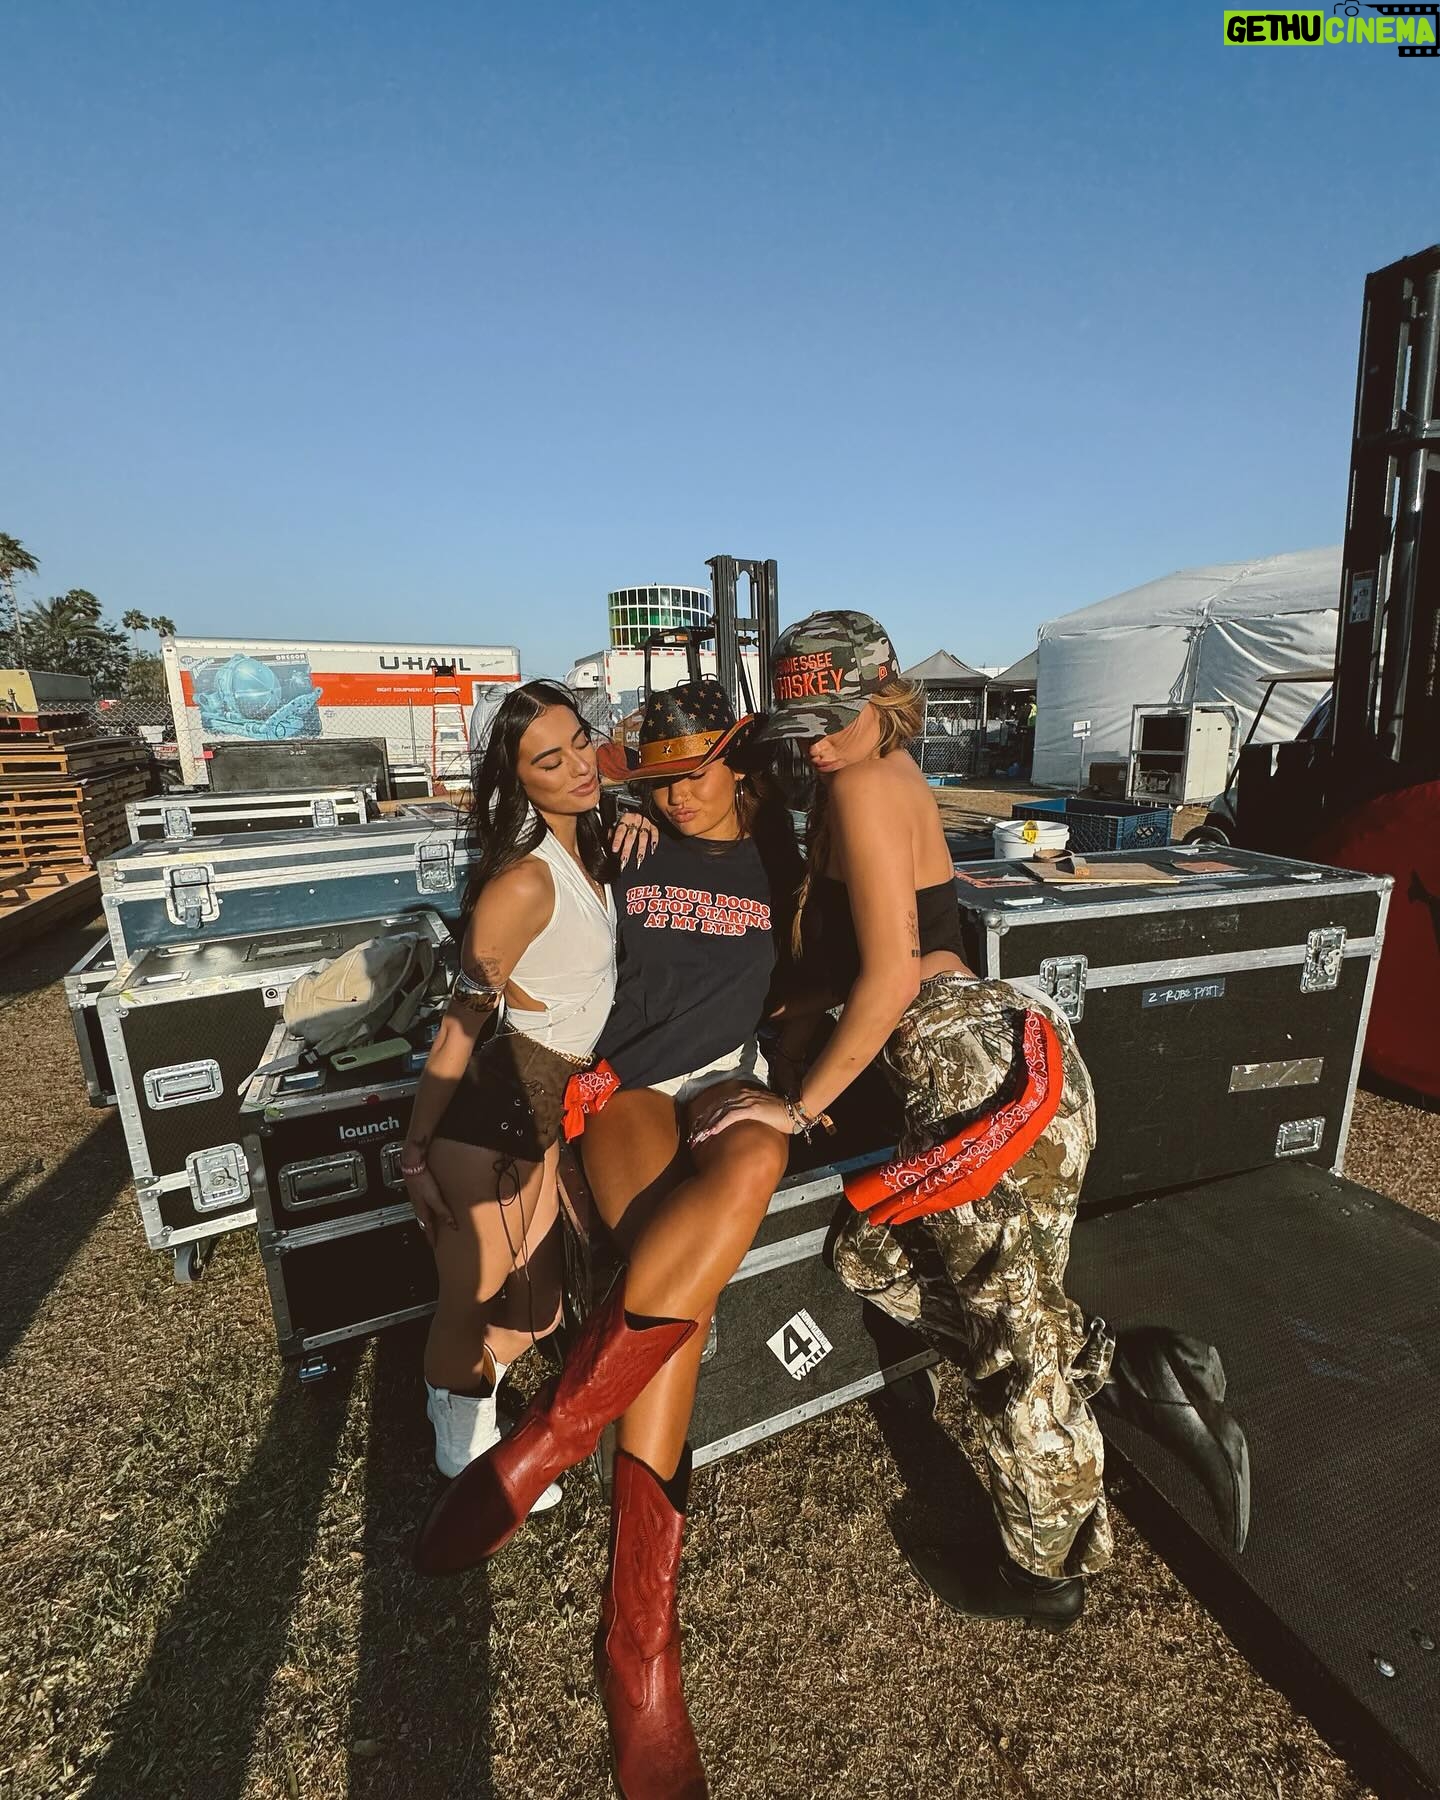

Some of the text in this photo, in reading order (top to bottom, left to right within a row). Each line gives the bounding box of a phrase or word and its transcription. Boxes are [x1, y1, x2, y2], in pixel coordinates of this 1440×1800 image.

[379, 656, 472, 671] U-HAUL
[777, 668, 844, 700] HISKEY
[626, 884, 771, 918] TELL YOUR BOOBS
[627, 899, 772, 930] TO STOP STARING
[644, 913, 747, 937] AT MY EYES
[339, 1116, 400, 1140] launch
[783, 1323, 813, 1365] 4
[792, 1347, 828, 1381] WALL
